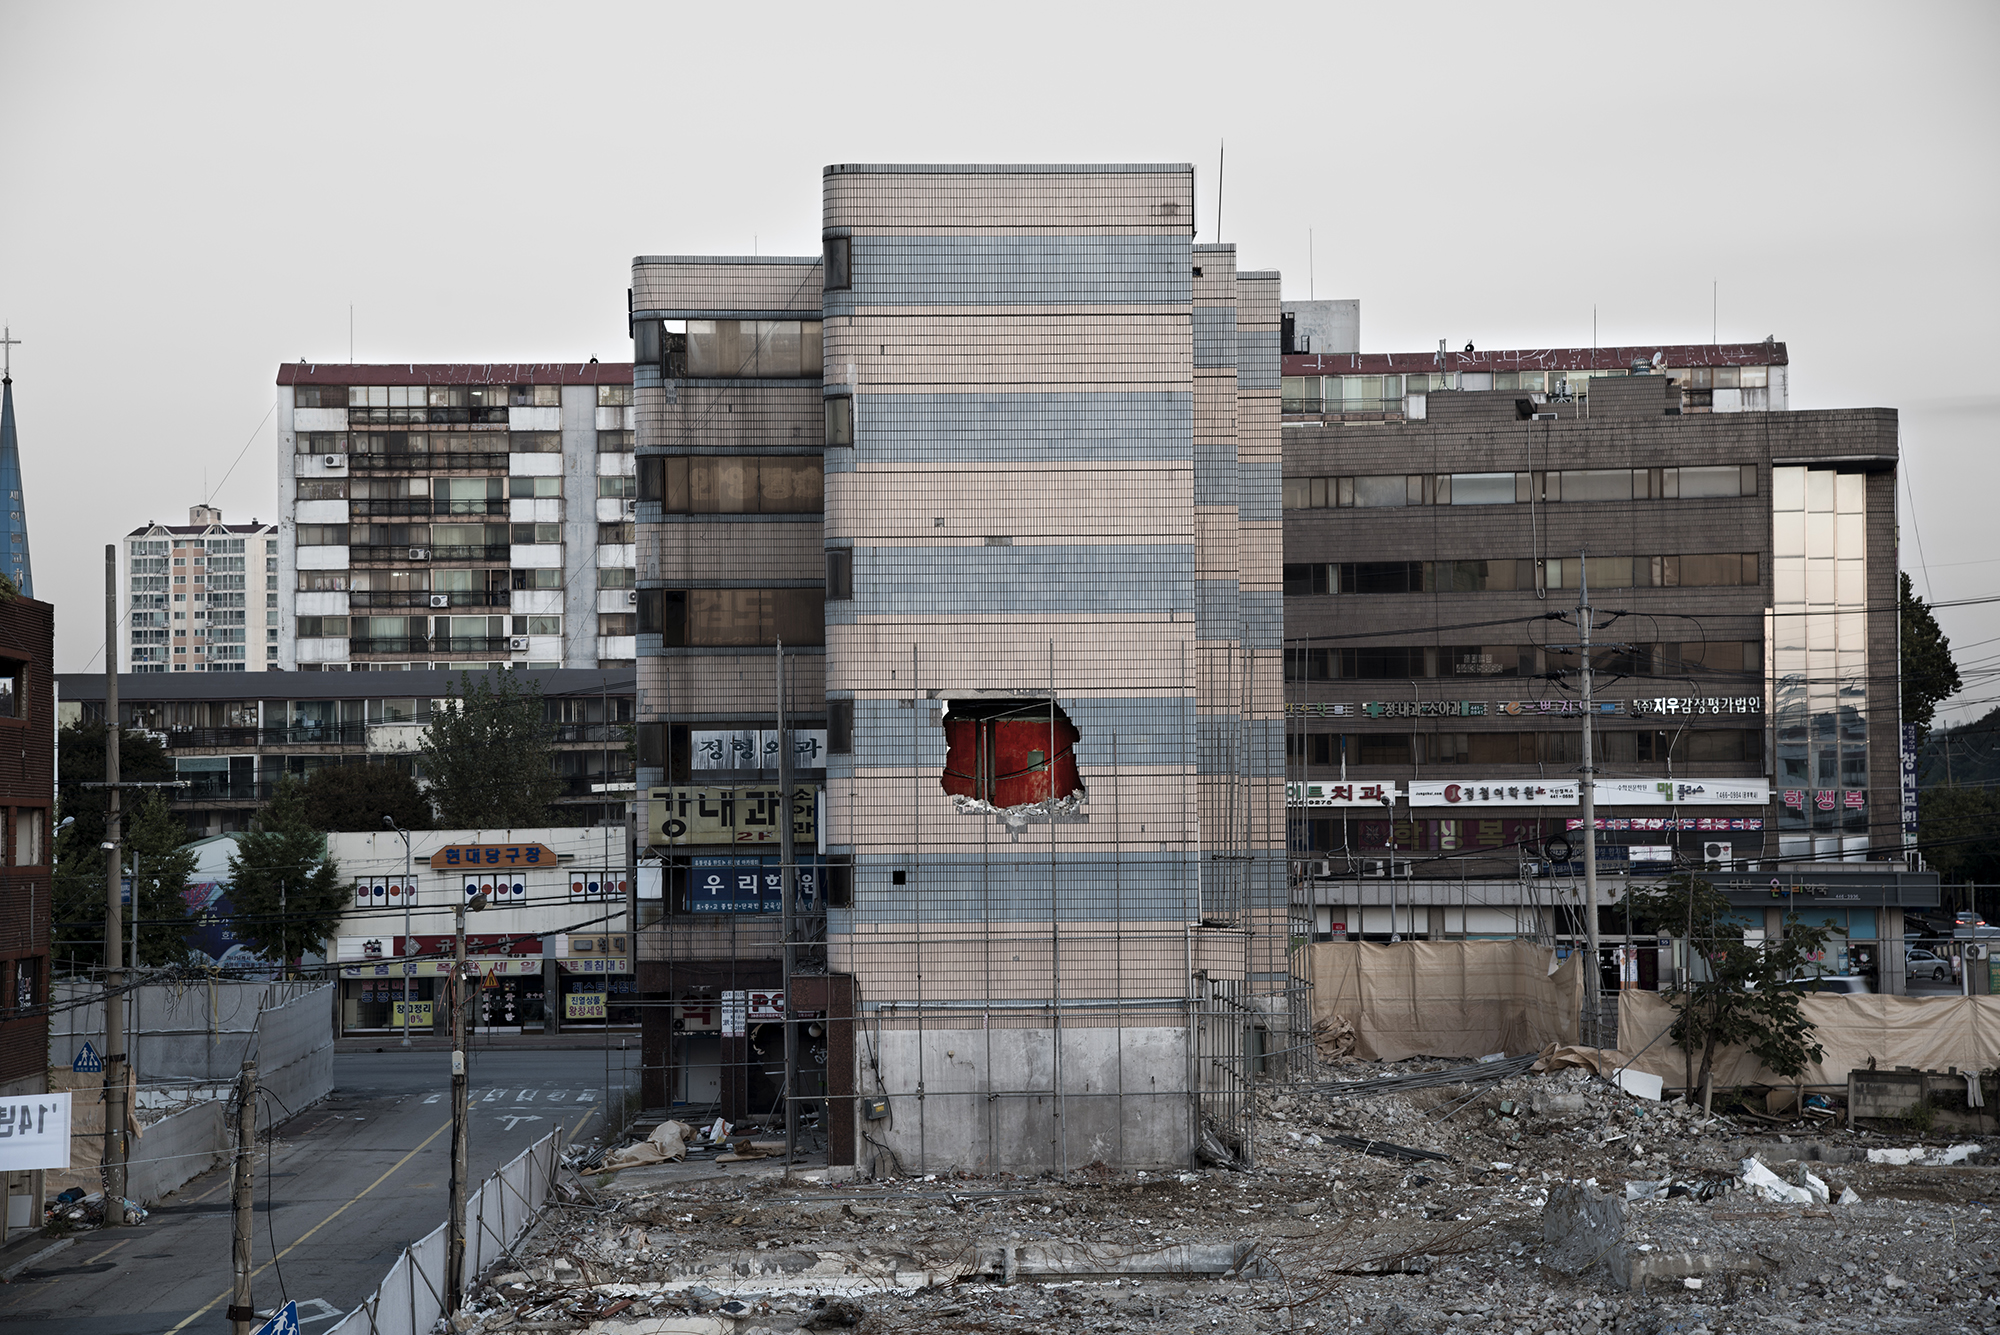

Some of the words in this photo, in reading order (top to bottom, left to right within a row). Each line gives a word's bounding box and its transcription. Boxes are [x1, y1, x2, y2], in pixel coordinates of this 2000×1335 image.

[1331, 784, 1385, 802] 치과
[1784, 790, 1865, 811] 학생복
[653, 791, 780, 838] 강내과
[446, 848, 541, 864] 현대당구장
